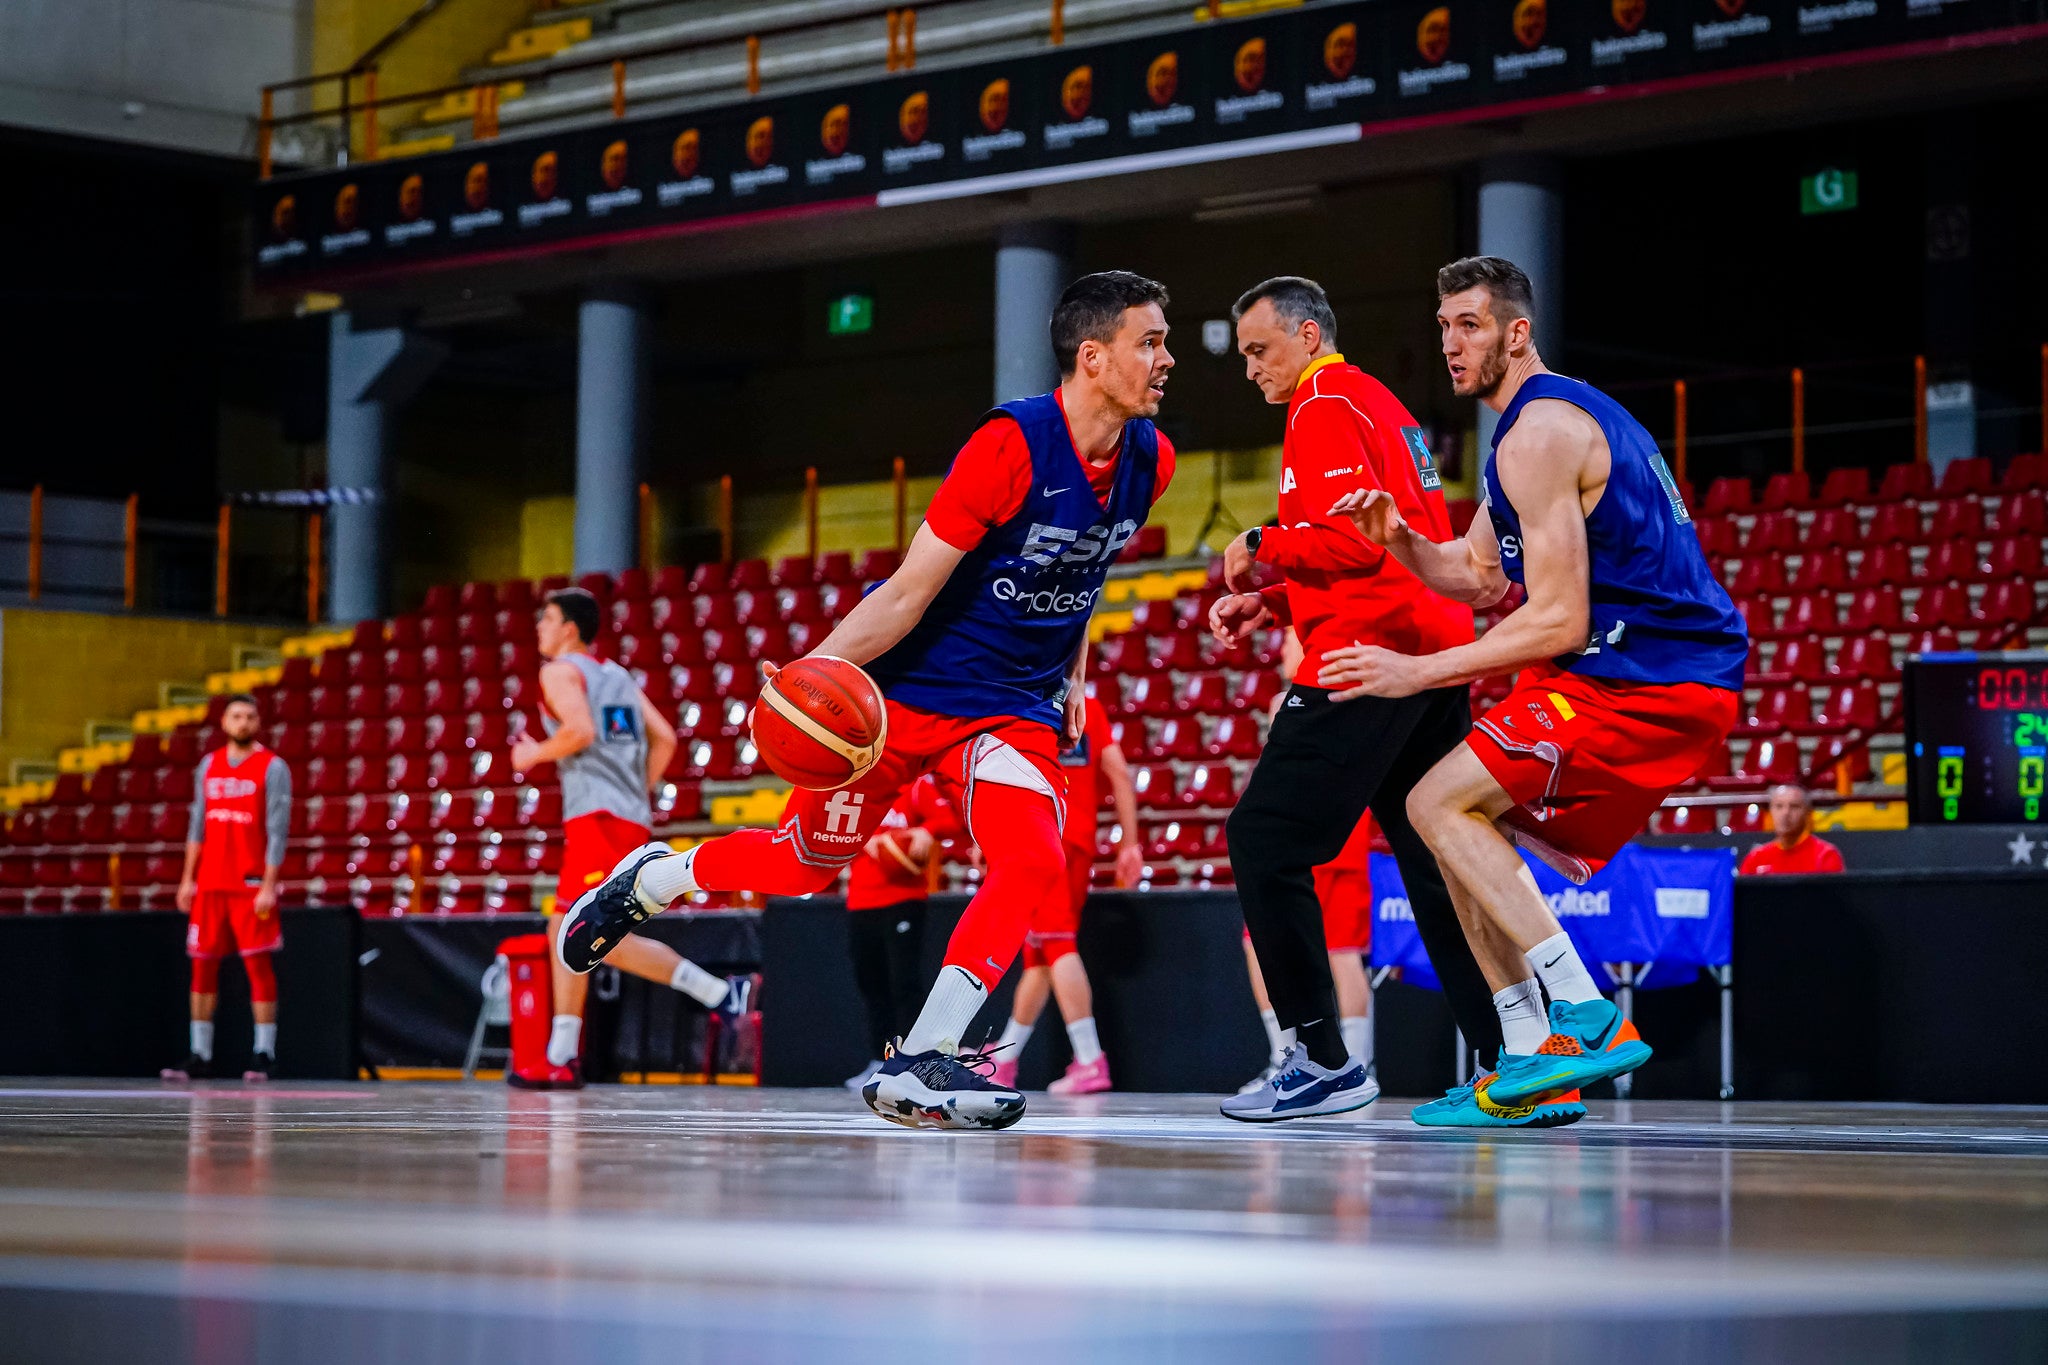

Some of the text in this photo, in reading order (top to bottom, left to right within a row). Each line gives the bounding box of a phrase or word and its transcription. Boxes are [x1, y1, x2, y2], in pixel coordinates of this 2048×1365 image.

[1324, 466, 1353, 478] IBERIA
[793, 676, 844, 717] molten
[1527, 702, 1554, 730] ESP
[1937, 756, 1964, 798] 0
[2018, 756, 2044, 798] 0
[824, 791, 865, 833] fi
[813, 831, 864, 844] network
